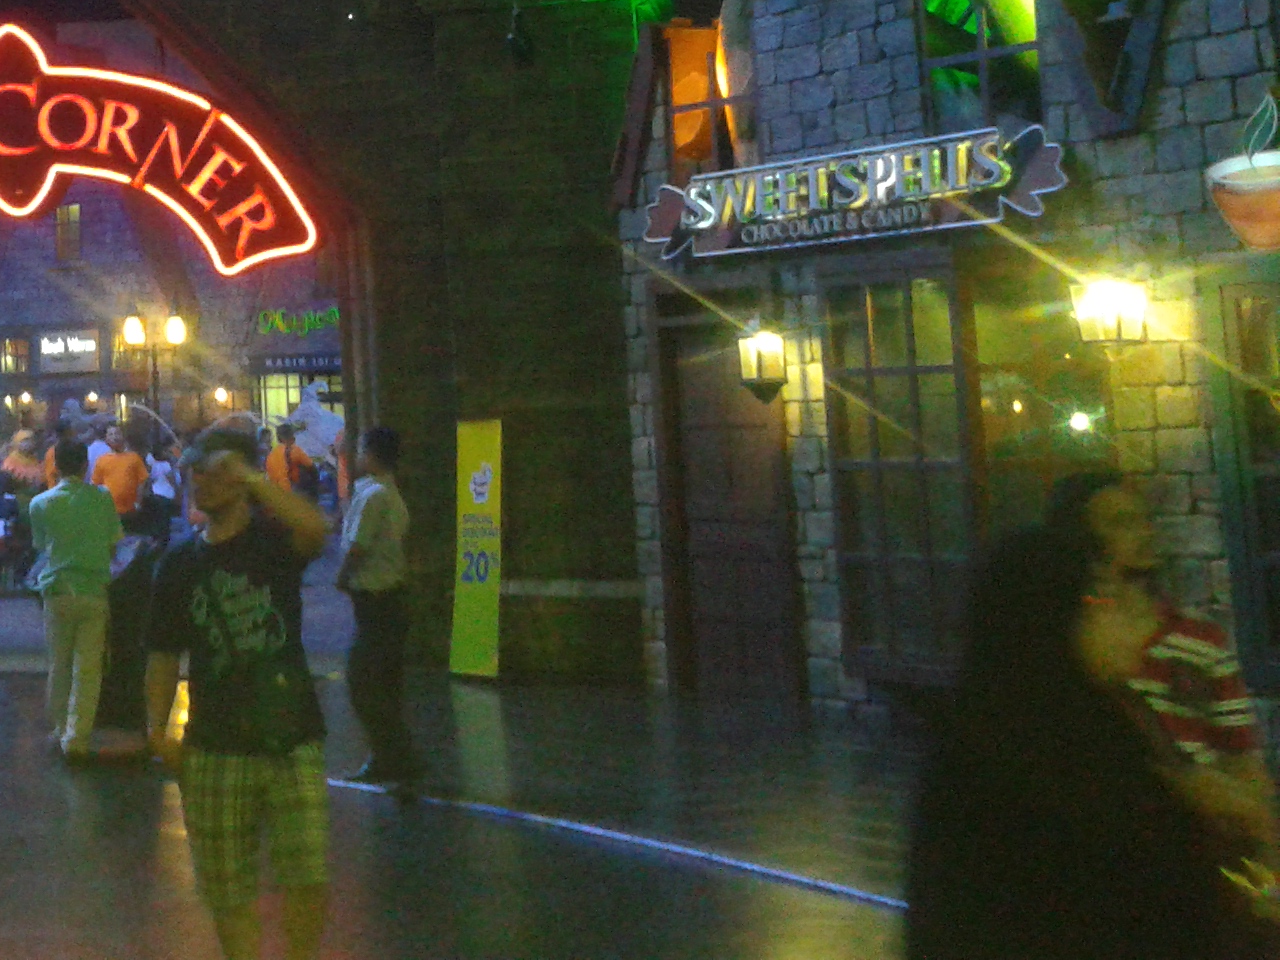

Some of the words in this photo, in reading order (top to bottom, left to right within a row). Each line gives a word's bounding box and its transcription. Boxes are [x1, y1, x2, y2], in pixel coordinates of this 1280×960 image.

[740, 213, 842, 244] CHOCOLATE
[845, 211, 859, 230] &
[861, 202, 933, 229] CANDY
